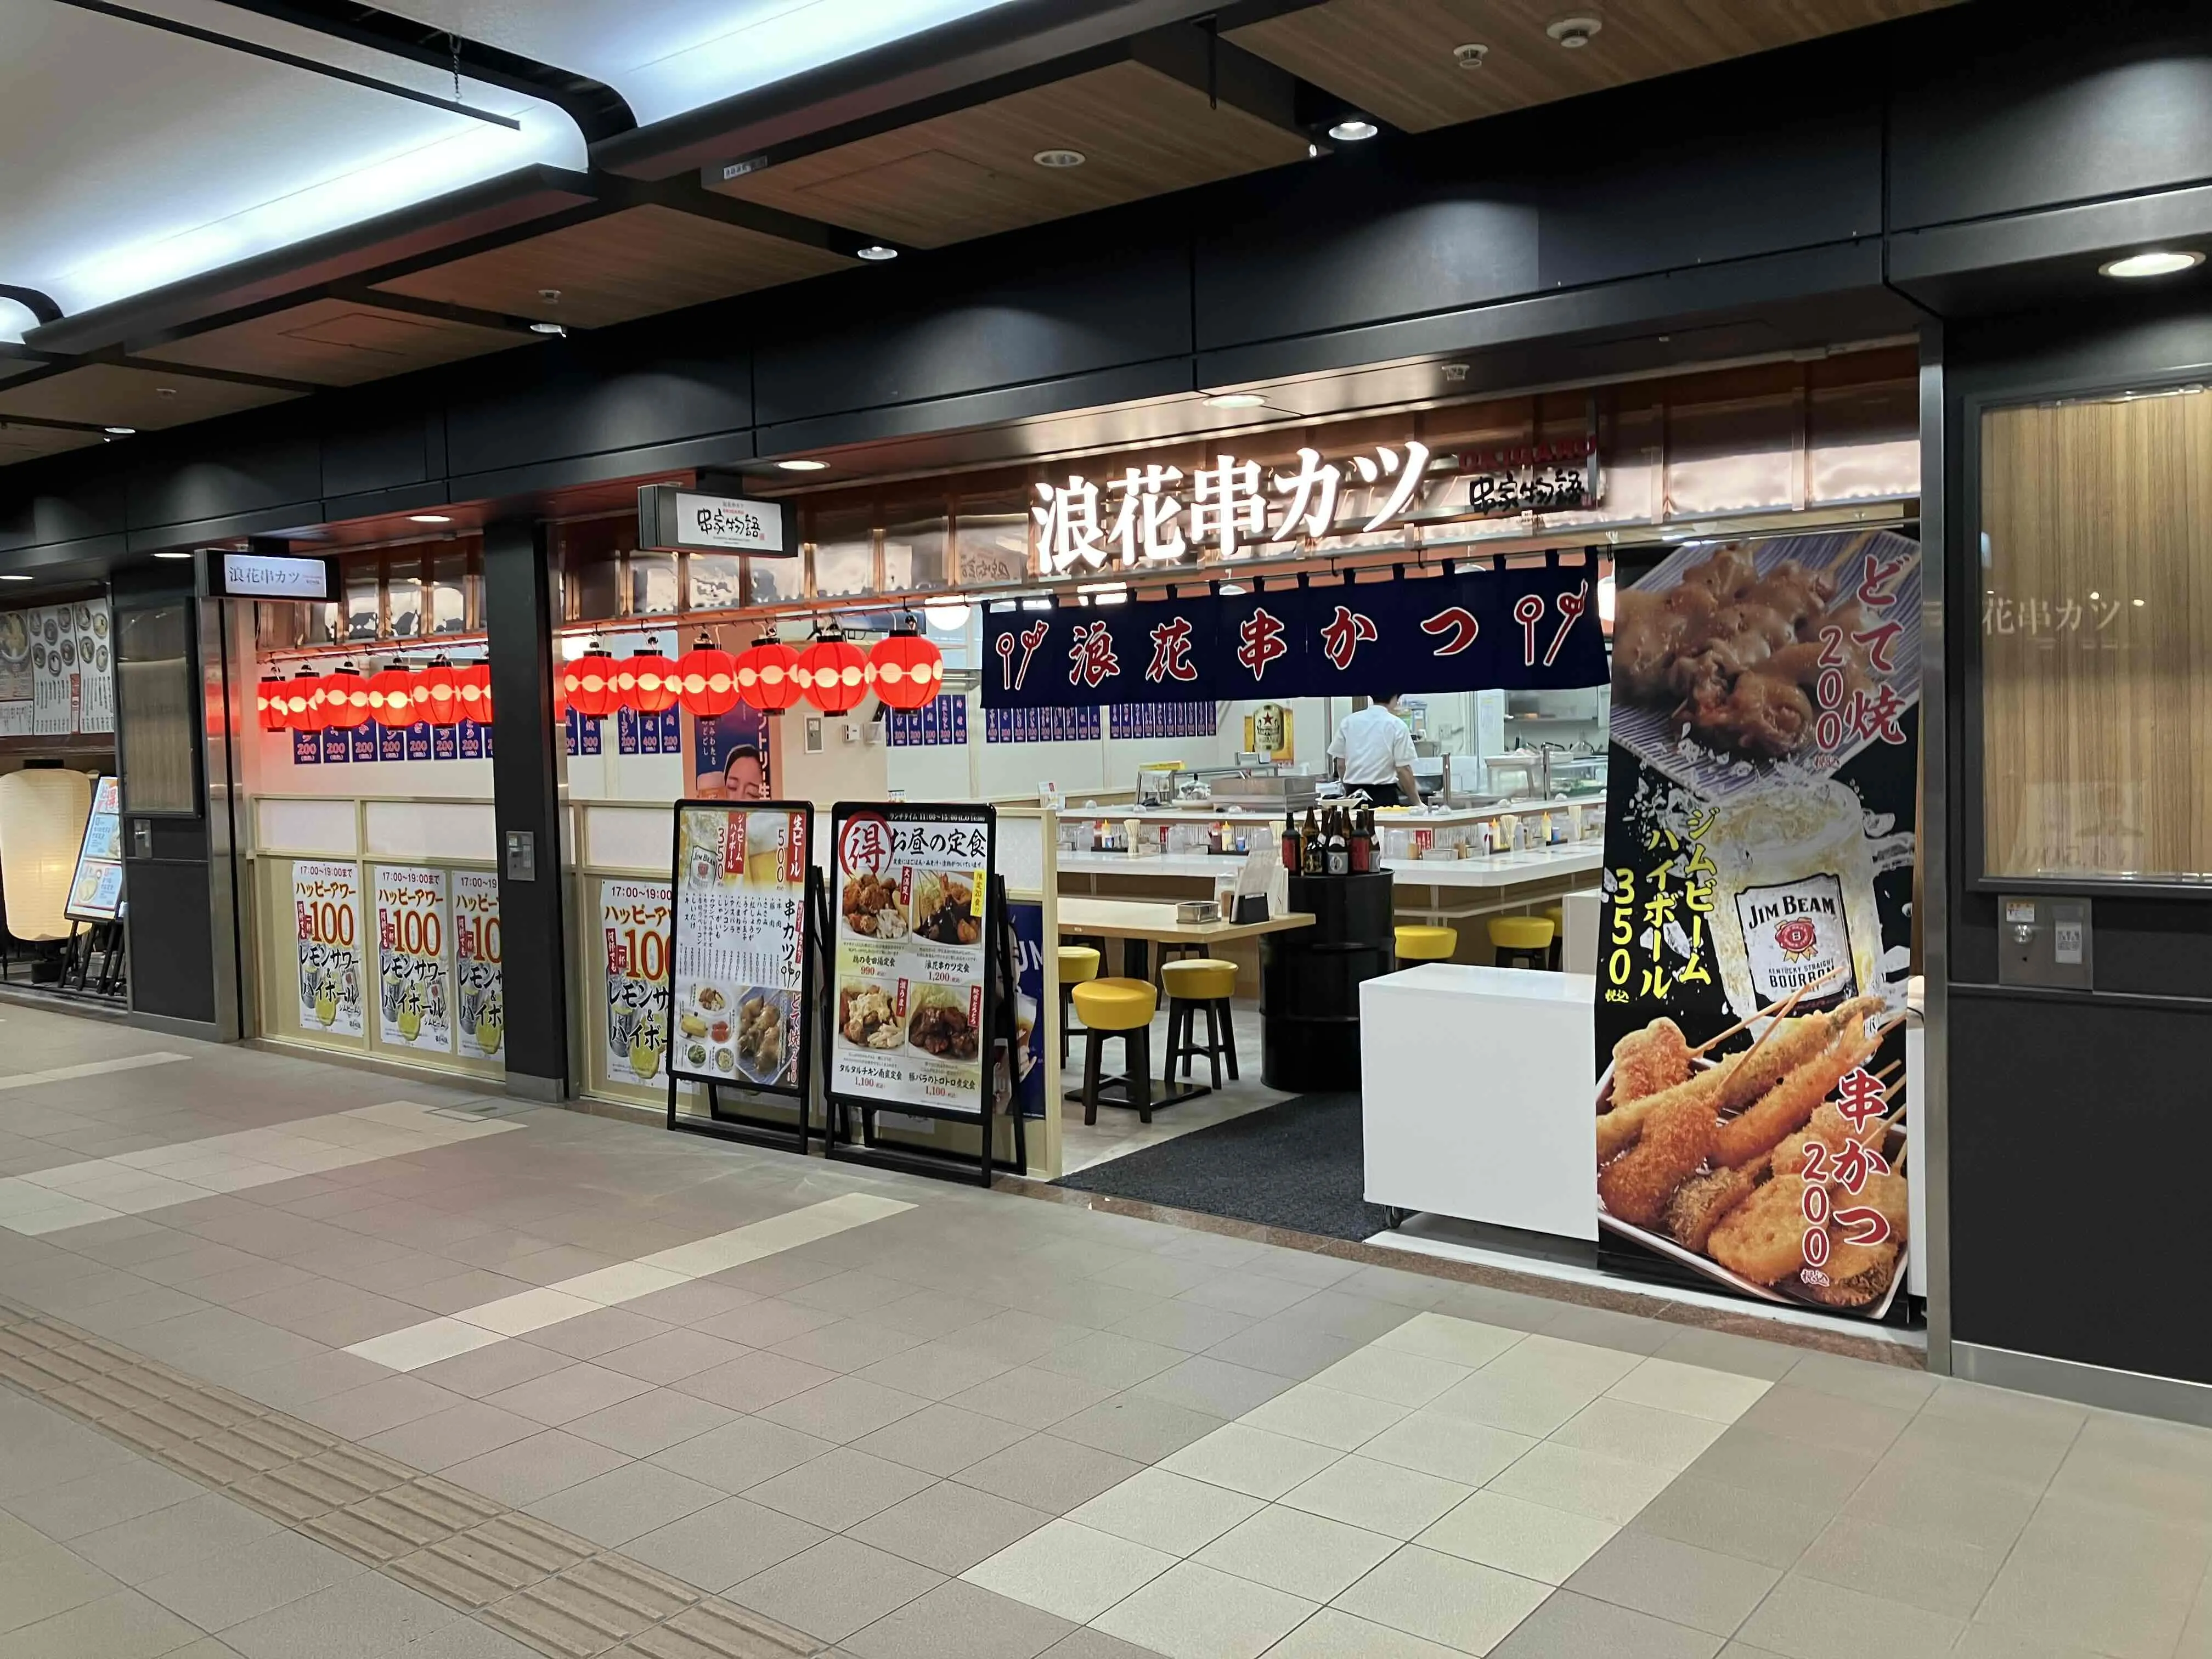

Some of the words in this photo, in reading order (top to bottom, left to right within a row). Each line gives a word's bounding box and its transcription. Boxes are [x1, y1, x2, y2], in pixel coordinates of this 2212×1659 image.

[1031, 441, 1430, 574] 浪花串カツ
[229, 566, 300, 584] 浪花串カツ
[1068, 605, 1480, 688] 浪花串かつ
[1844, 554, 1907, 744] どて焼
[1815, 625, 1845, 752] 200
[716, 828, 725, 880] 350
[777, 829, 785, 883] 500
[791, 814, 803, 877] 生ビール
[848, 823, 886, 874] 得
[892, 827, 986, 857] お昼の定食
[296, 881, 356, 899] ハッピーアワー
[379, 888, 443, 907] ハッピーアワー
[456, 894, 499, 912] ハッピー
[1678, 807, 1719, 986] ジムビーム
[310, 901, 354, 945] 100
[605, 904, 672, 926] ハッピーア
[1609, 868, 1635, 985] 350
[1640, 828, 1679, 1000] ハイボール
[1749, 904, 1779, 929] JIM
[1782, 895, 1837, 915] BEAM
[393, 910, 441, 956] 100
[473, 917, 500, 963] 10
[781, 898, 796, 961] 串カツ
[300, 945, 359, 969] レモンサワー
[381, 956, 448, 981] レモンサワー
[1768, 964, 1801, 974] KENTUCKY
[459, 964, 501, 988] レモンサ
[928, 973, 950, 983] 1,200
[303, 981, 358, 1005] ハイボール
[386, 994, 443, 1018] ハイボール
[608, 981, 668, 1011] レモンサ
[462, 1004, 501, 1028] ハイボ
[612, 1025, 667, 1051] ハイボー
[855, 1077, 874, 1088] 1,100
[926, 1086, 945, 1097] 1,100
[1831, 1066, 1890, 1246] 串かつ
[1802, 1142, 1830, 1268] 200
